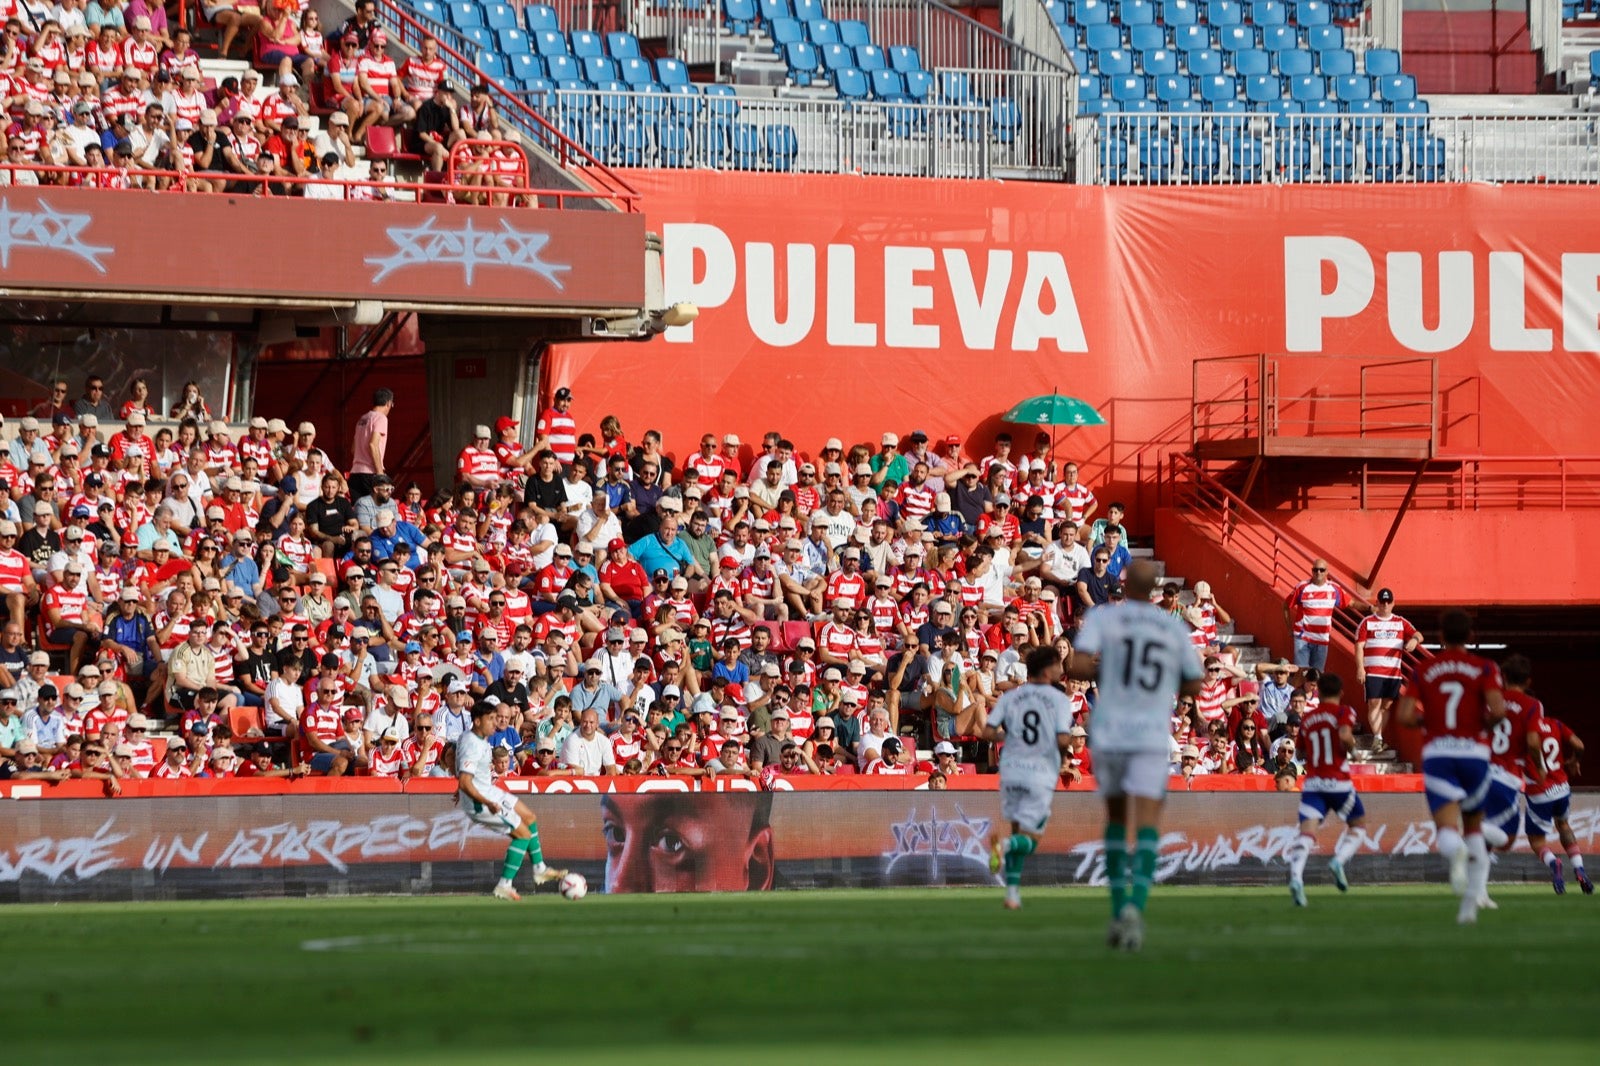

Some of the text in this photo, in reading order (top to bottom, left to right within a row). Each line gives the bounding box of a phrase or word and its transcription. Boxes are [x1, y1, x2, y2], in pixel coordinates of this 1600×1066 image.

[662, 222, 1089, 353] PULEVA
[828, 523, 851, 537] OMMY
[1121, 637, 1165, 693] 15
[1439, 681, 1464, 729] 7
[1022, 710, 1041, 746] 8
[1309, 727, 1334, 768] 11
[1491, 717, 1512, 755] 8
[142, 831, 208, 877] UN
